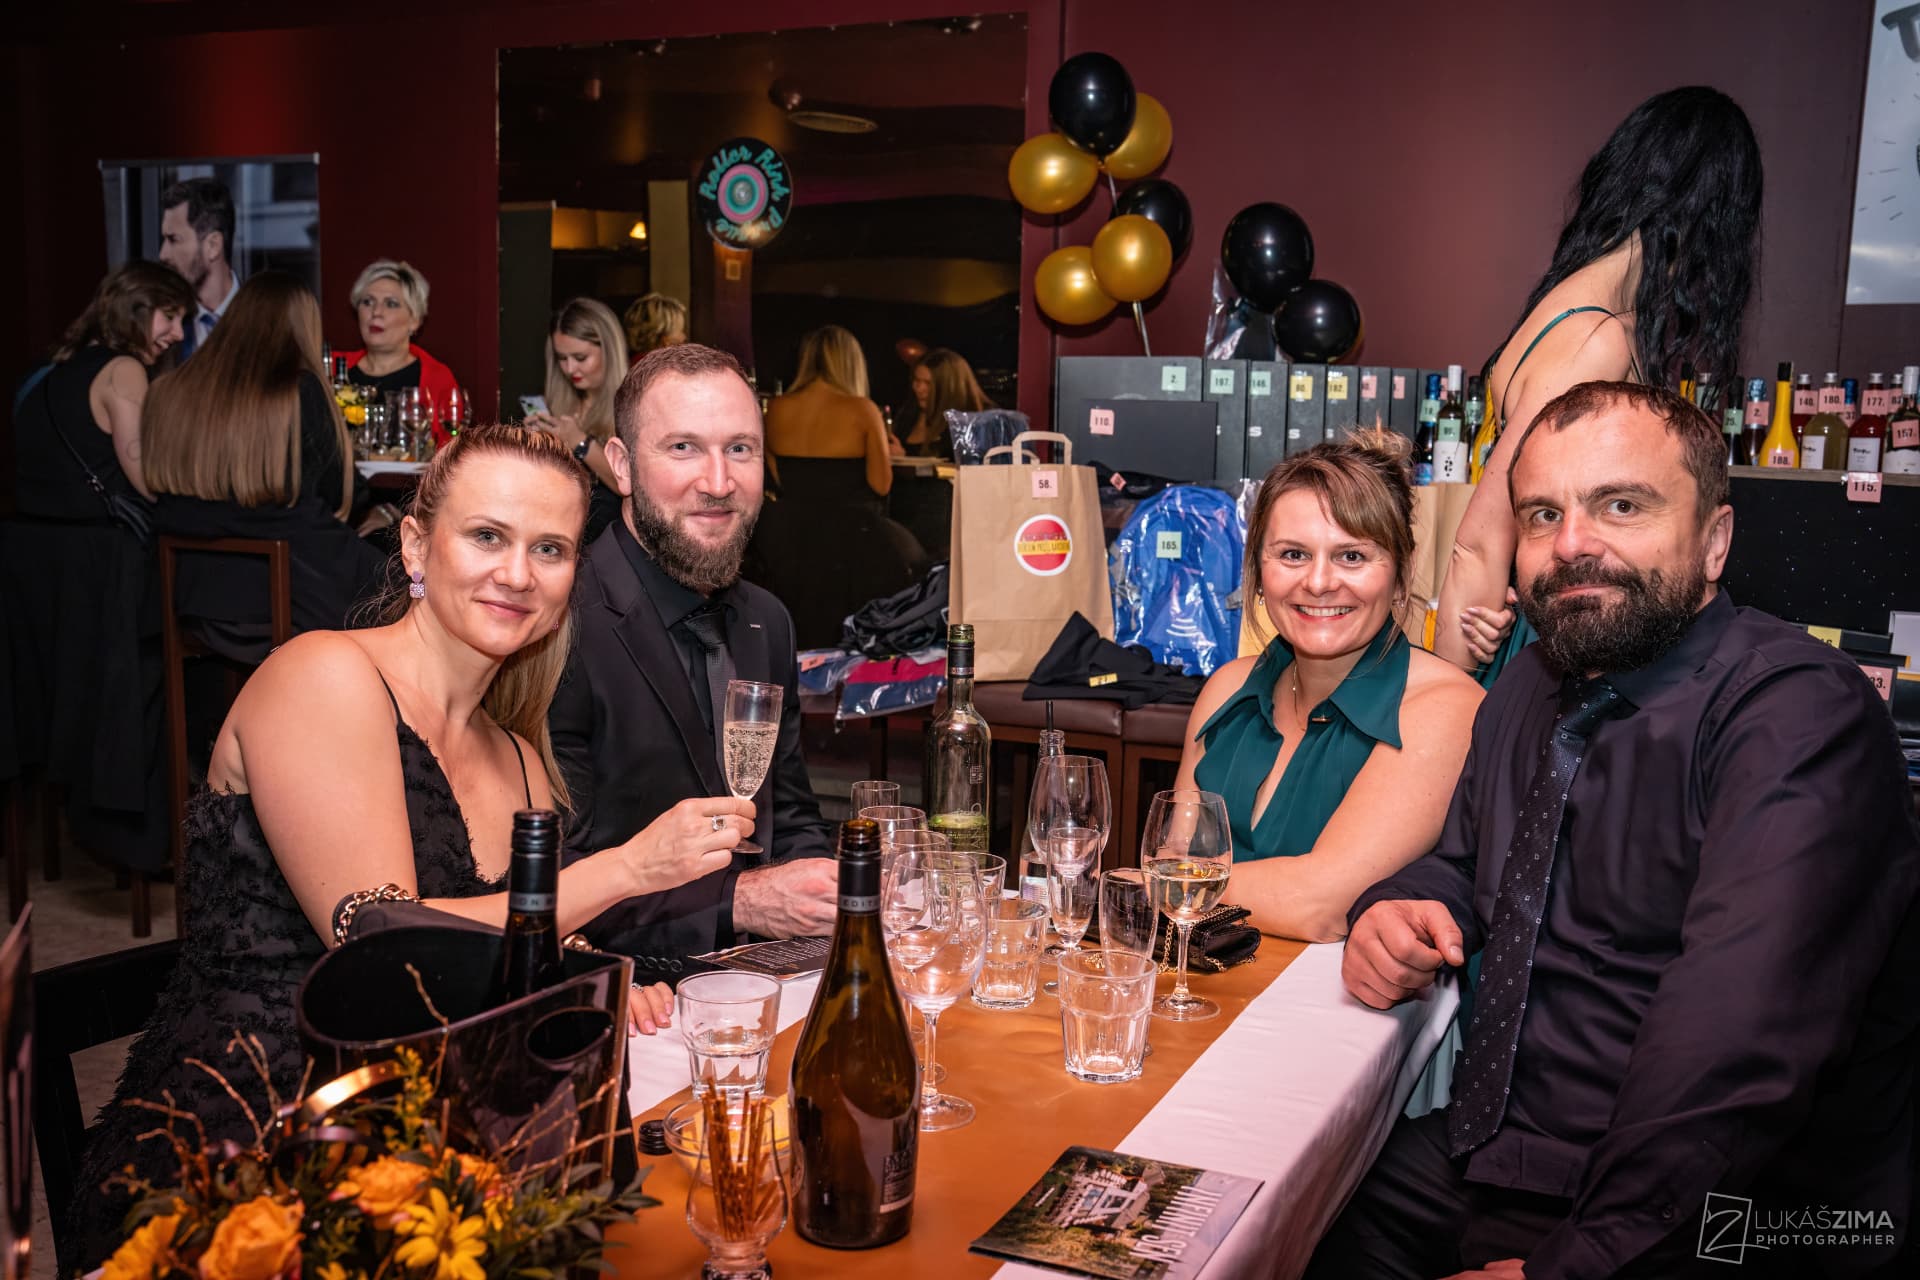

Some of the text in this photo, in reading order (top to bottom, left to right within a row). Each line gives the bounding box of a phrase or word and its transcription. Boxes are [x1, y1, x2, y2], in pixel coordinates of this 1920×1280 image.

[699, 145, 753, 200] Roller
[755, 147, 790, 201] Rink
[1867, 397, 1885, 407] 177.
[1038, 479, 1053, 489] 58.
[1854, 481, 1877, 492] 115.
[1151, 1185, 1223, 1238] INFINIT
